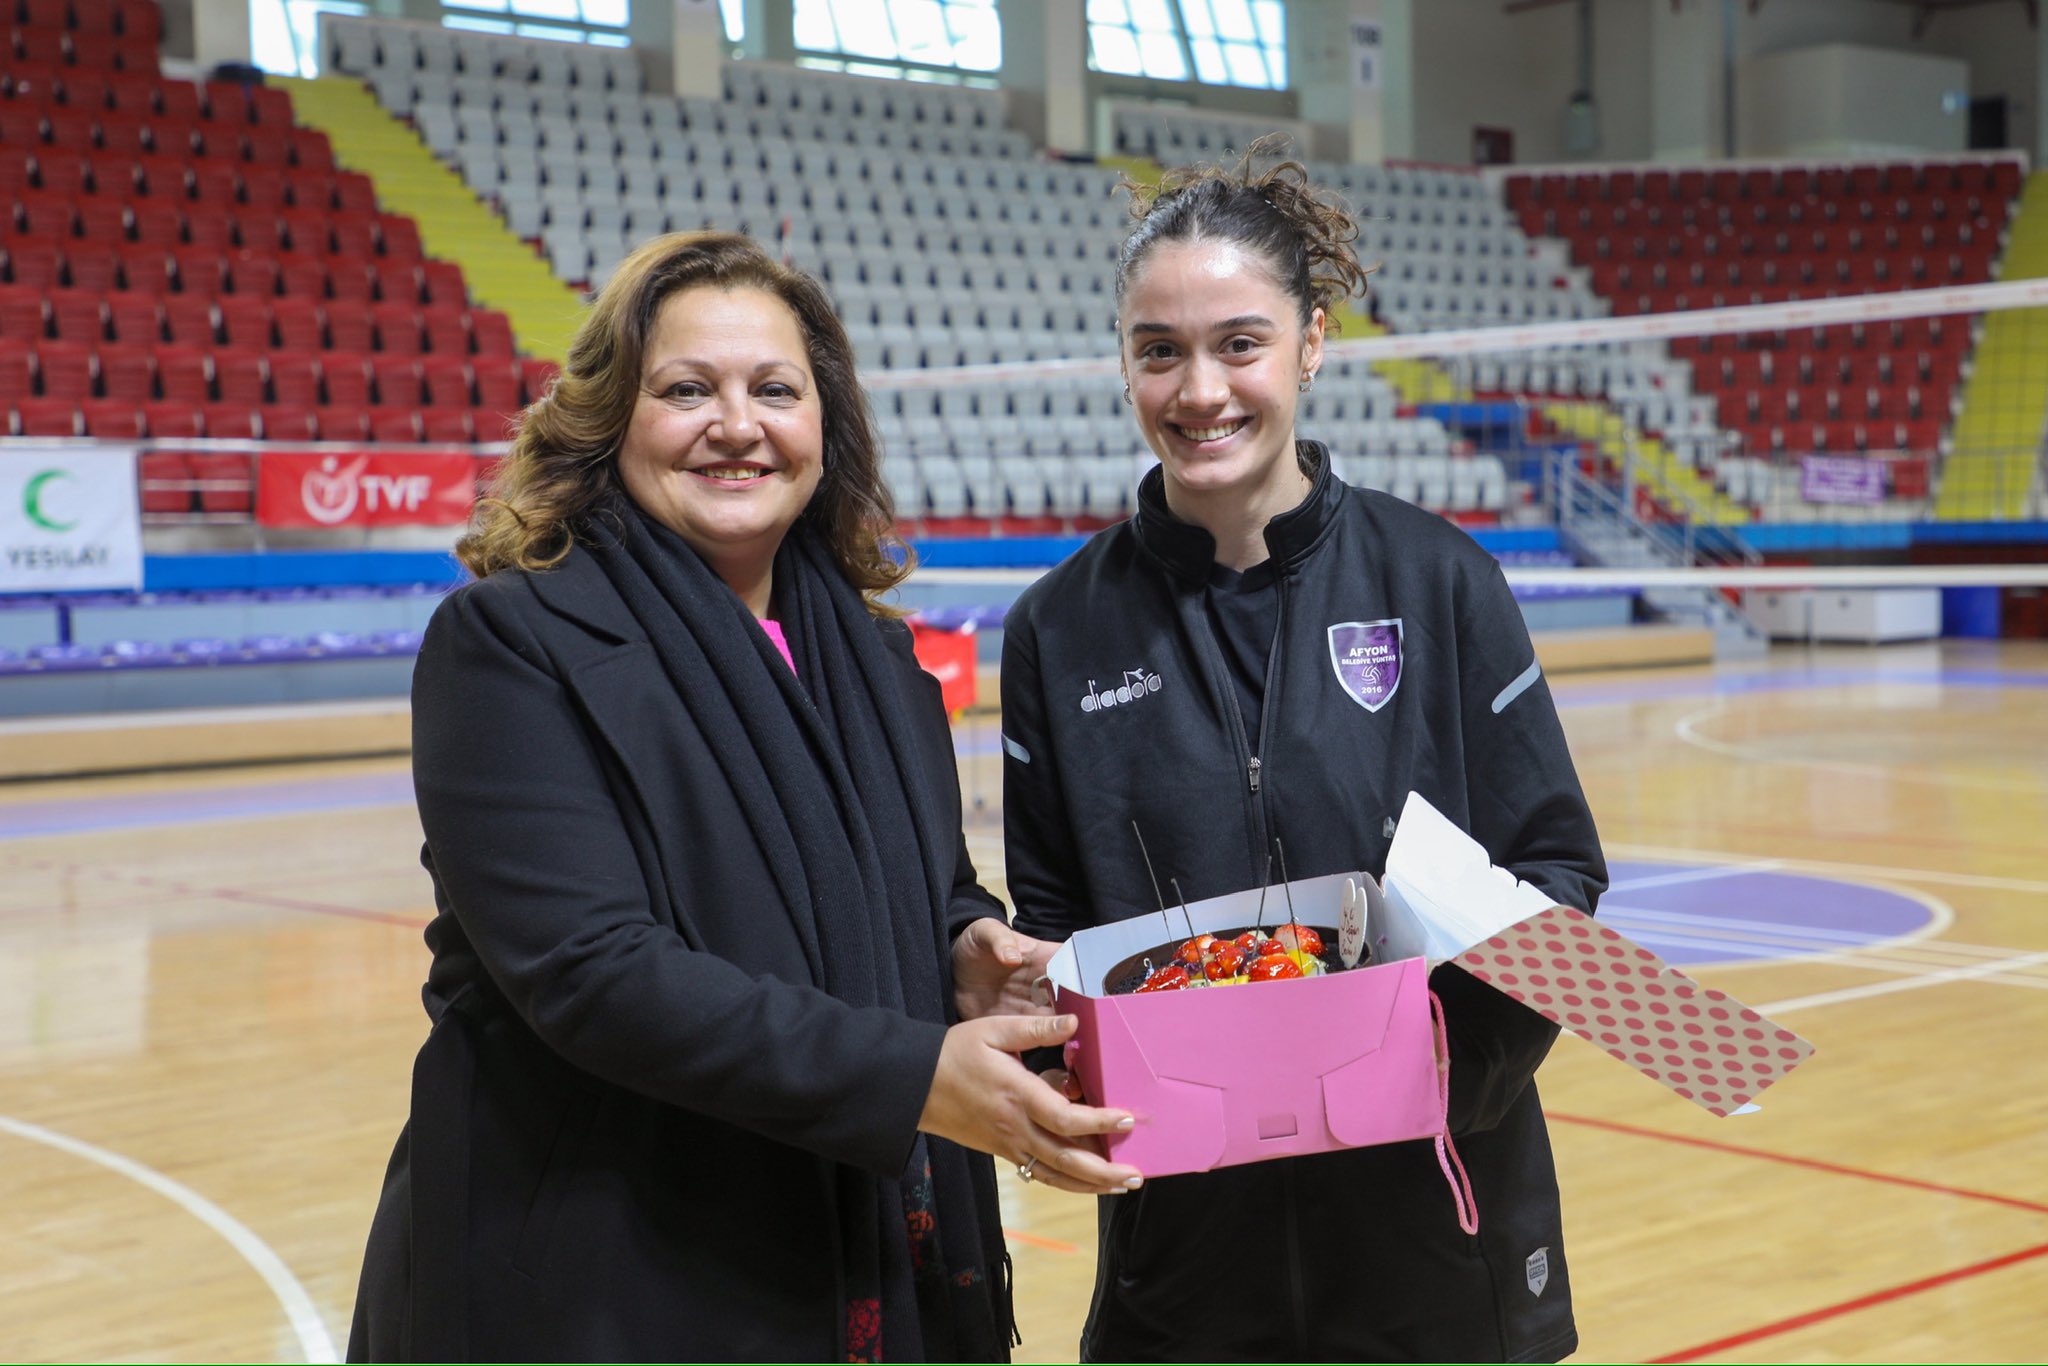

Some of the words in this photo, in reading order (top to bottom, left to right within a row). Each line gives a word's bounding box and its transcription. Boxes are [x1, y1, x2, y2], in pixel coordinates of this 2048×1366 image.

[361, 474, 432, 512] TVF
[1349, 645, 1388, 657] AFYON
[1341, 657, 1371, 665] BELEDİYE
[1080, 669, 1162, 712] diadora
[1361, 685, 1382, 694] 2016
